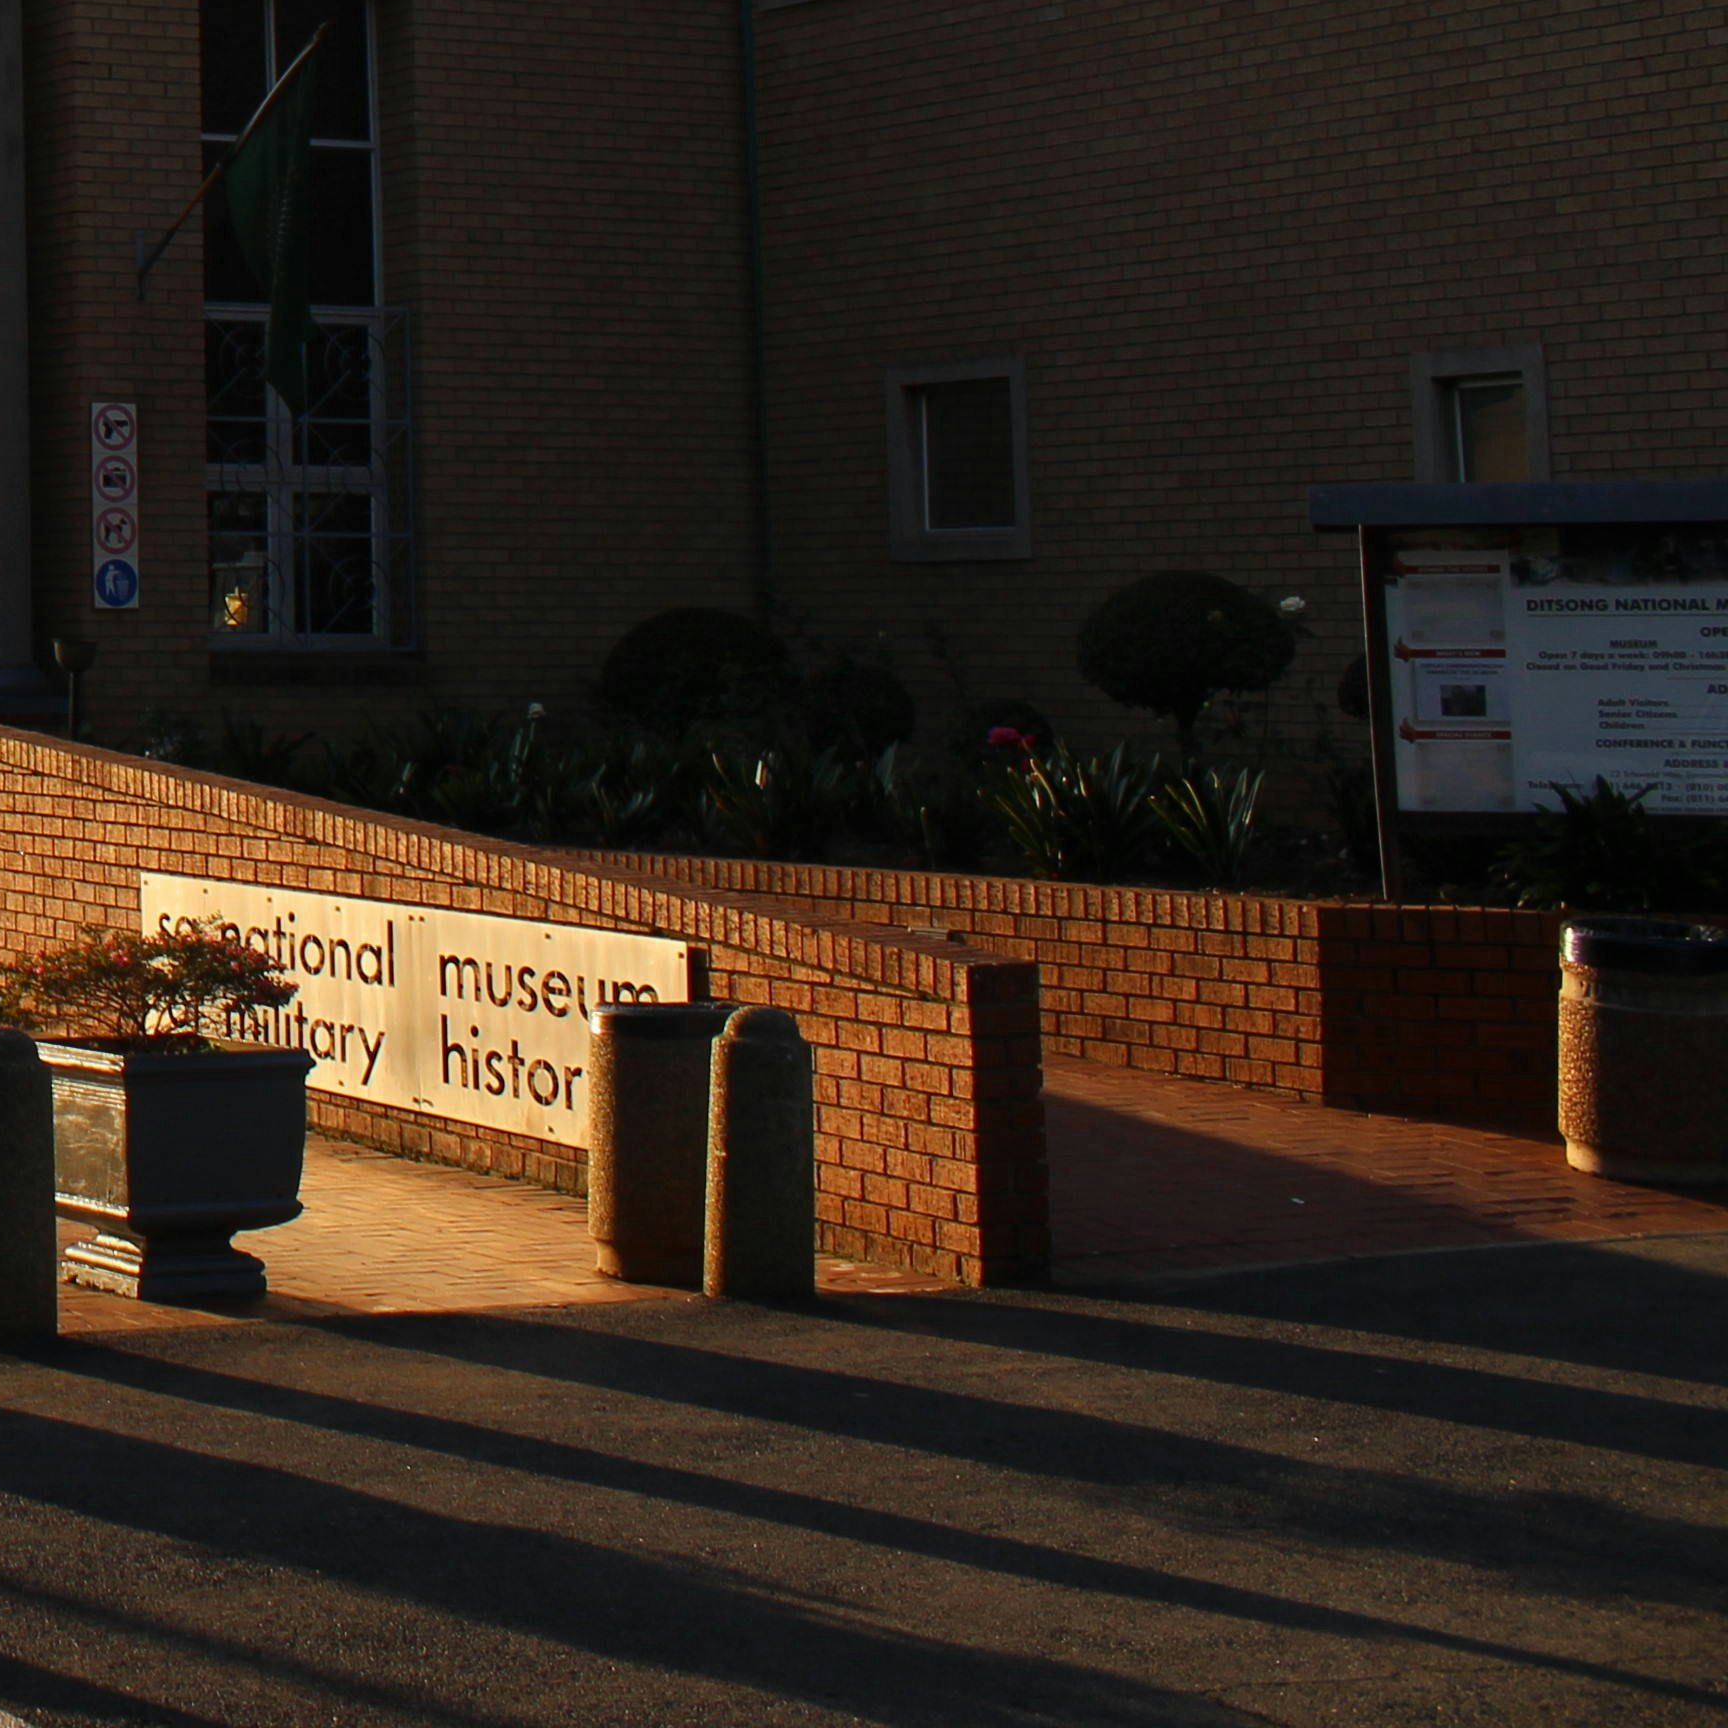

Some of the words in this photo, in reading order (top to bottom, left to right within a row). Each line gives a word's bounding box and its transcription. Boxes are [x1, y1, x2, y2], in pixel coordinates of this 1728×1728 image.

[1526, 598, 1609, 612] DITSONG
[1614, 598, 1710, 611] NATIONAL
[1609, 639, 1658, 649] MUSEUM
[1599, 720, 1645, 730] Children
[1595, 738, 1674, 749] CONFERENCE
[1663, 758, 1718, 768] ADDRESS
